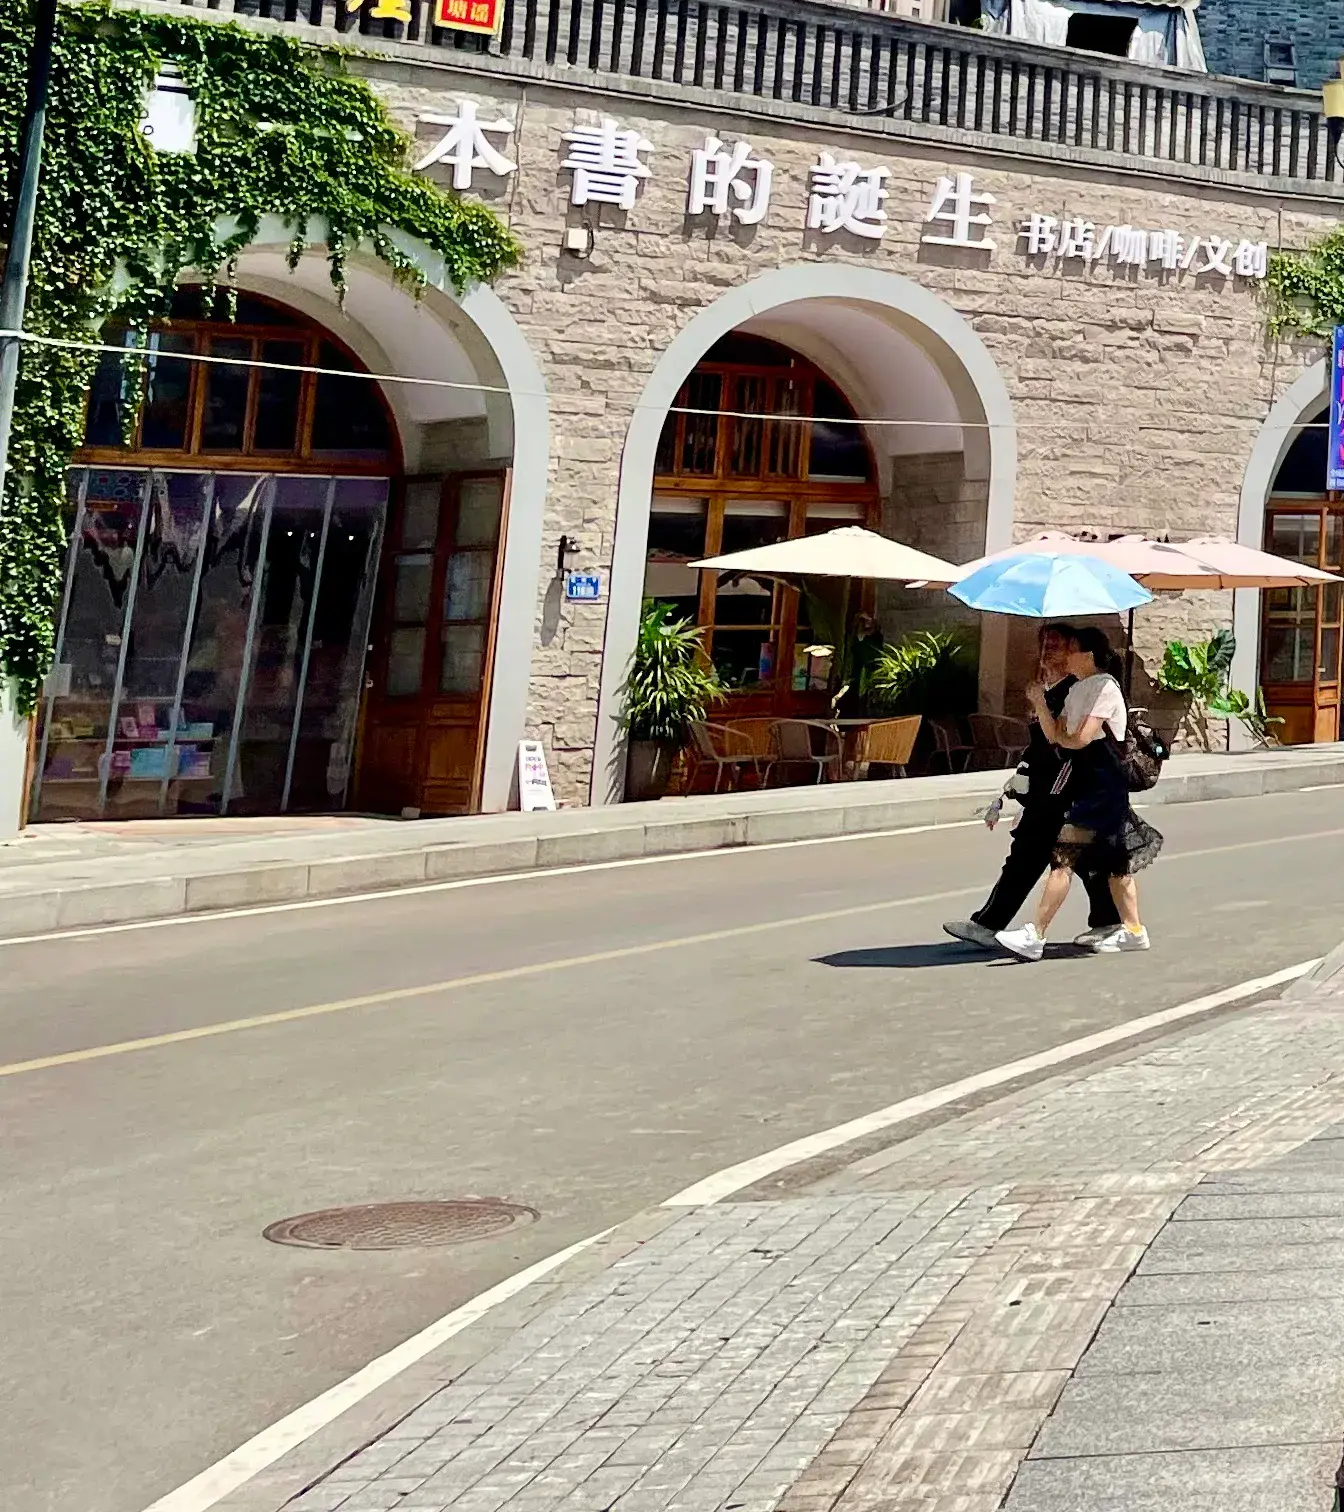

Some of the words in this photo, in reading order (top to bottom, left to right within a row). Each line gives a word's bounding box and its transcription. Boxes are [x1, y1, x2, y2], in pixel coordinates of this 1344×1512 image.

[413, 100, 998, 251] 本書的誕生
[1018, 213, 1268, 279] 书店/咖啡/文创
